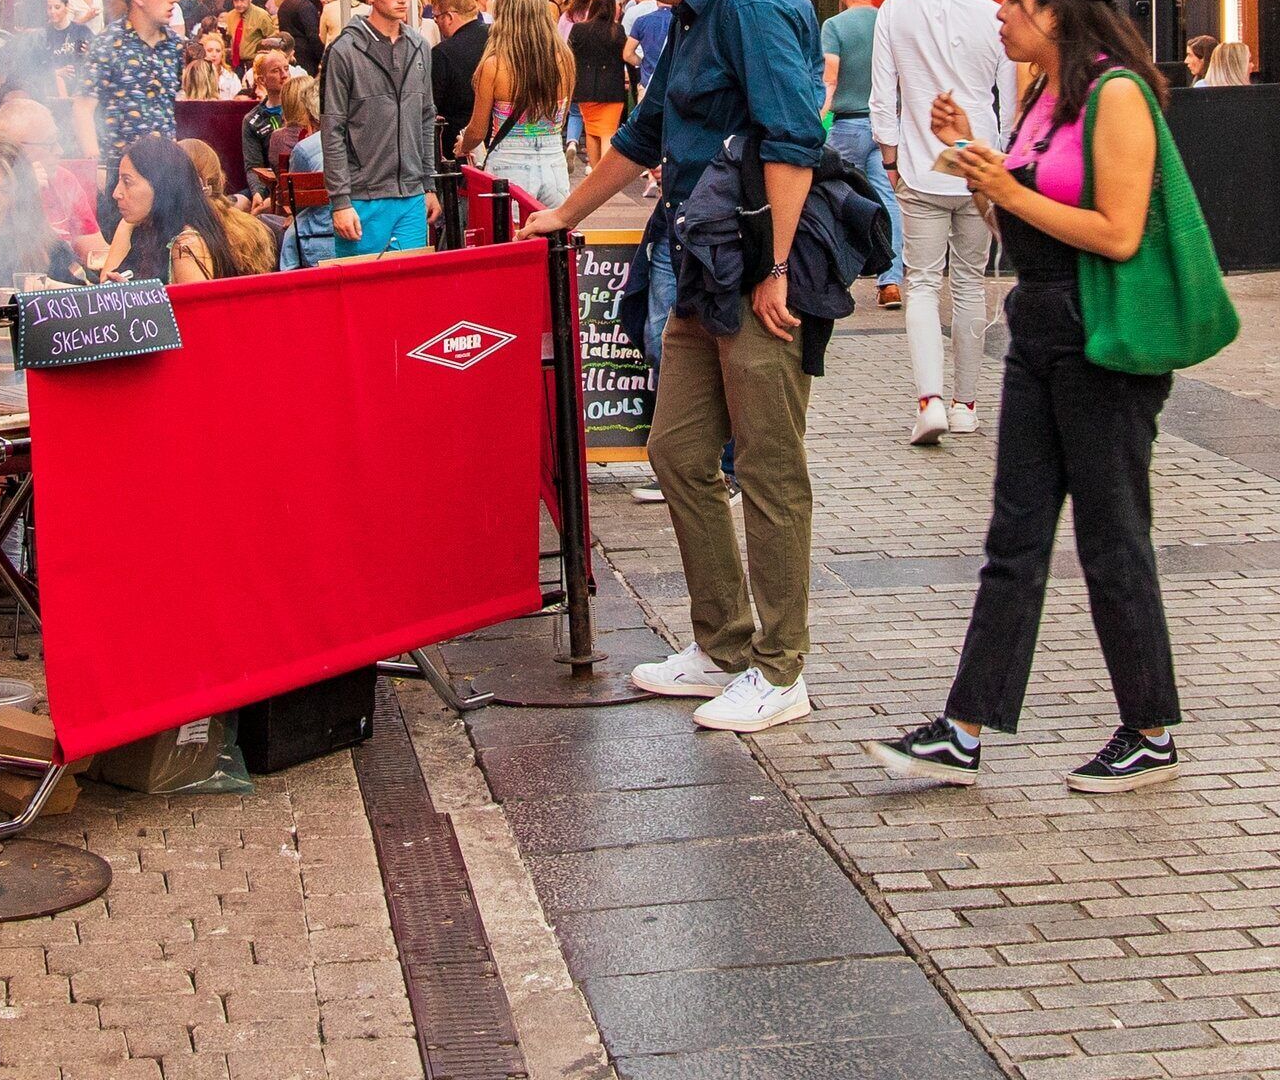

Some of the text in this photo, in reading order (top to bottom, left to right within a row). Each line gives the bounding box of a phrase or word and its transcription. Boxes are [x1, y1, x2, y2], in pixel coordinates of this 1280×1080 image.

[26, 295, 82, 326] IRISH
[51, 318, 159, 356] SKEWERS €10
[443, 334, 482, 353] EMBER
